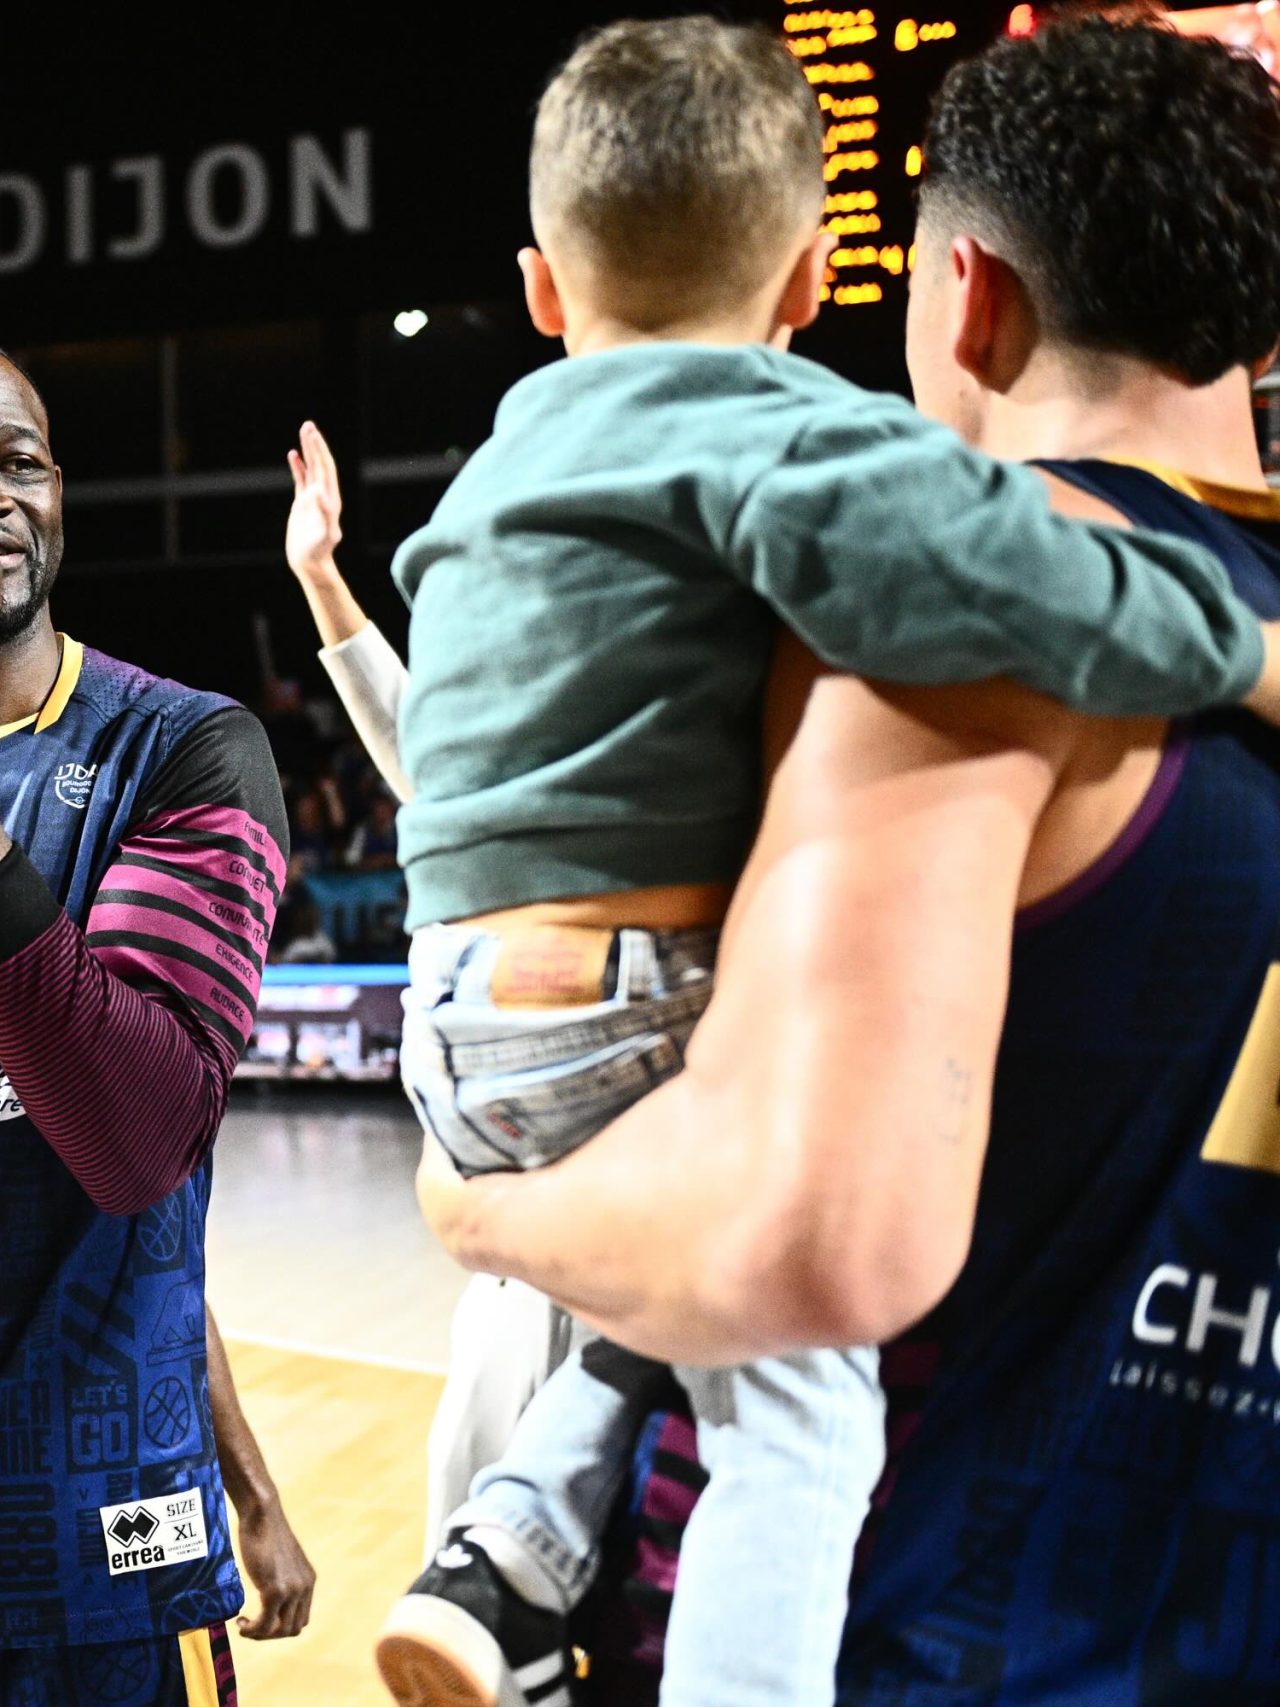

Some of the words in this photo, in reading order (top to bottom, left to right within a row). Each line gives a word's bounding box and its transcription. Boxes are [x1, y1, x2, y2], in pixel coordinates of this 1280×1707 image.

[210, 987, 245, 1022] AUDACE
[1131, 1262, 1280, 1370] CH
[71, 1411, 131, 1466] GO
[166, 1498, 196, 1517] SIZE
[173, 1522, 197, 1542] XL
